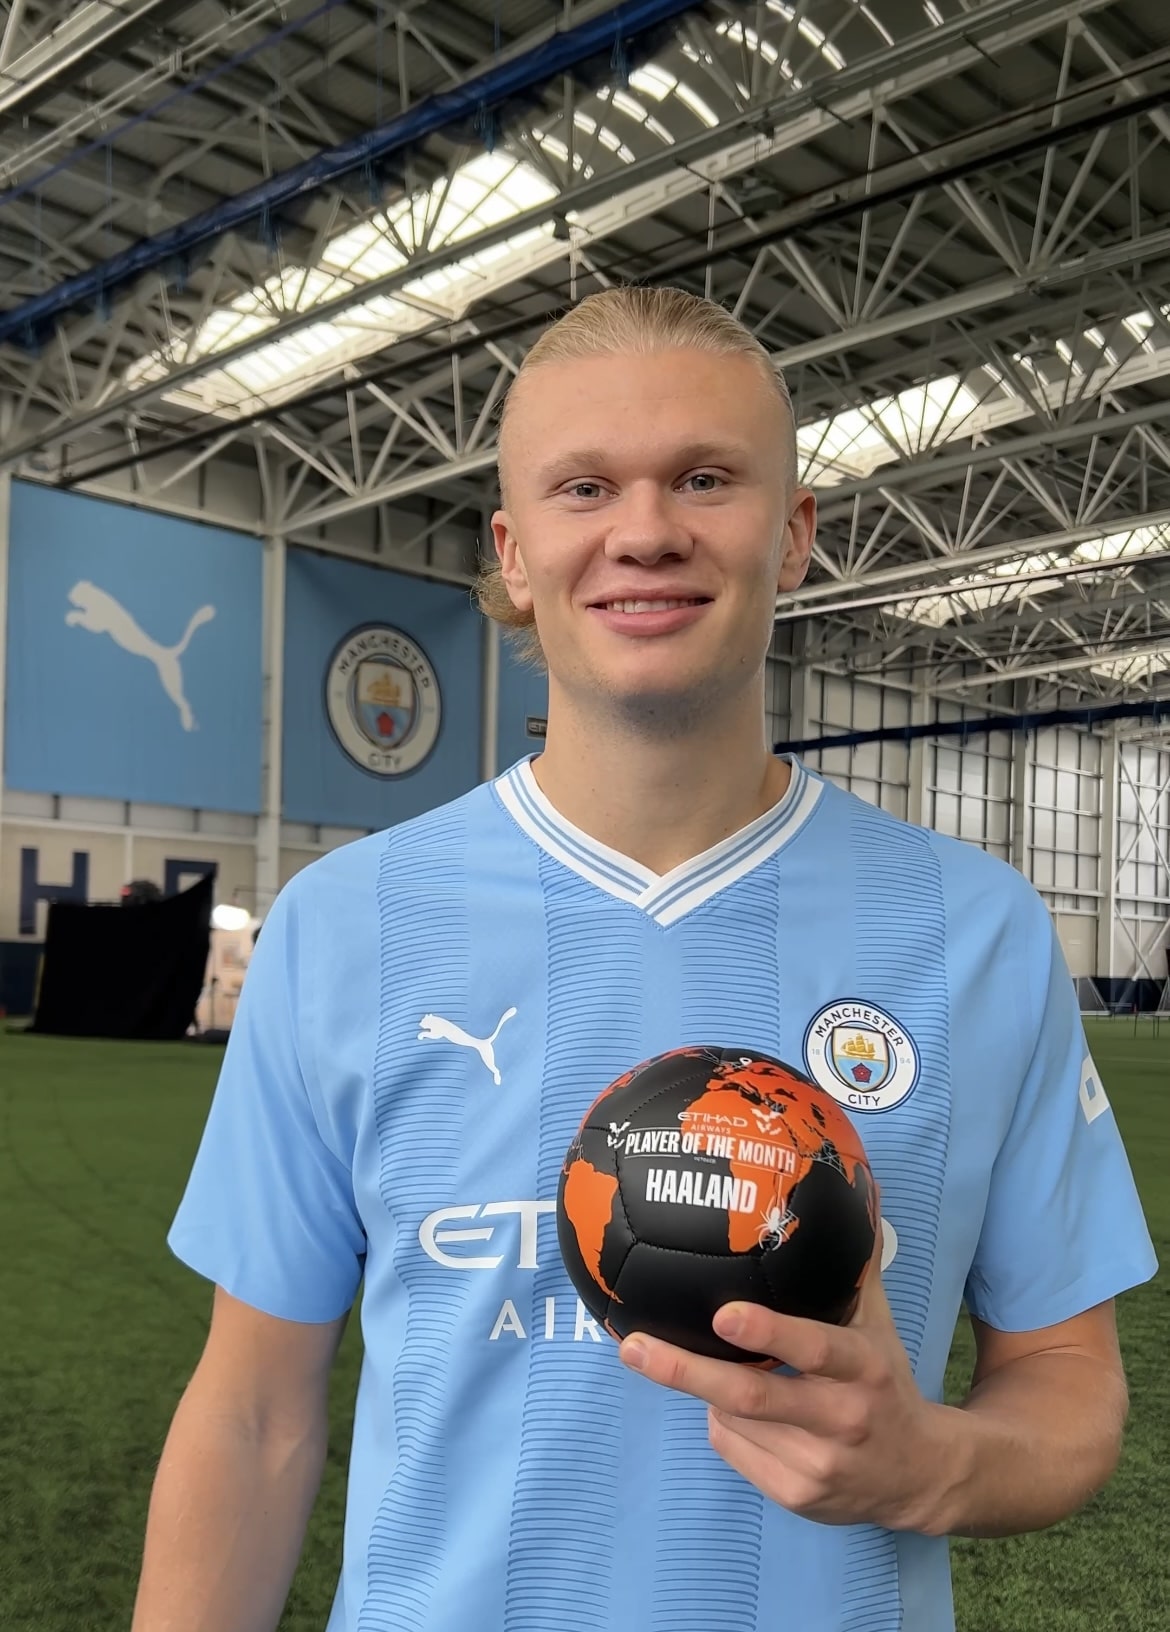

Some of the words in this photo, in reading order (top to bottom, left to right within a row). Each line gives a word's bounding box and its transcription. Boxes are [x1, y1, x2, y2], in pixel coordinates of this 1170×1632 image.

[337, 634, 430, 689] MANCHESTER
[367, 752, 403, 768] CITY
[815, 1007, 904, 1047] MANCHESTER
[847, 1093, 881, 1107] CITY
[677, 1111, 749, 1128] ETIHAD
[690, 1124, 731, 1135] AIRWAYS
[624, 1130, 681, 1155] PLAYER
[682, 1132, 704, 1155] OF
[705, 1133, 737, 1160] THE
[737, 1138, 796, 1175] MONTH
[645, 1168, 759, 1214] HAALAND
